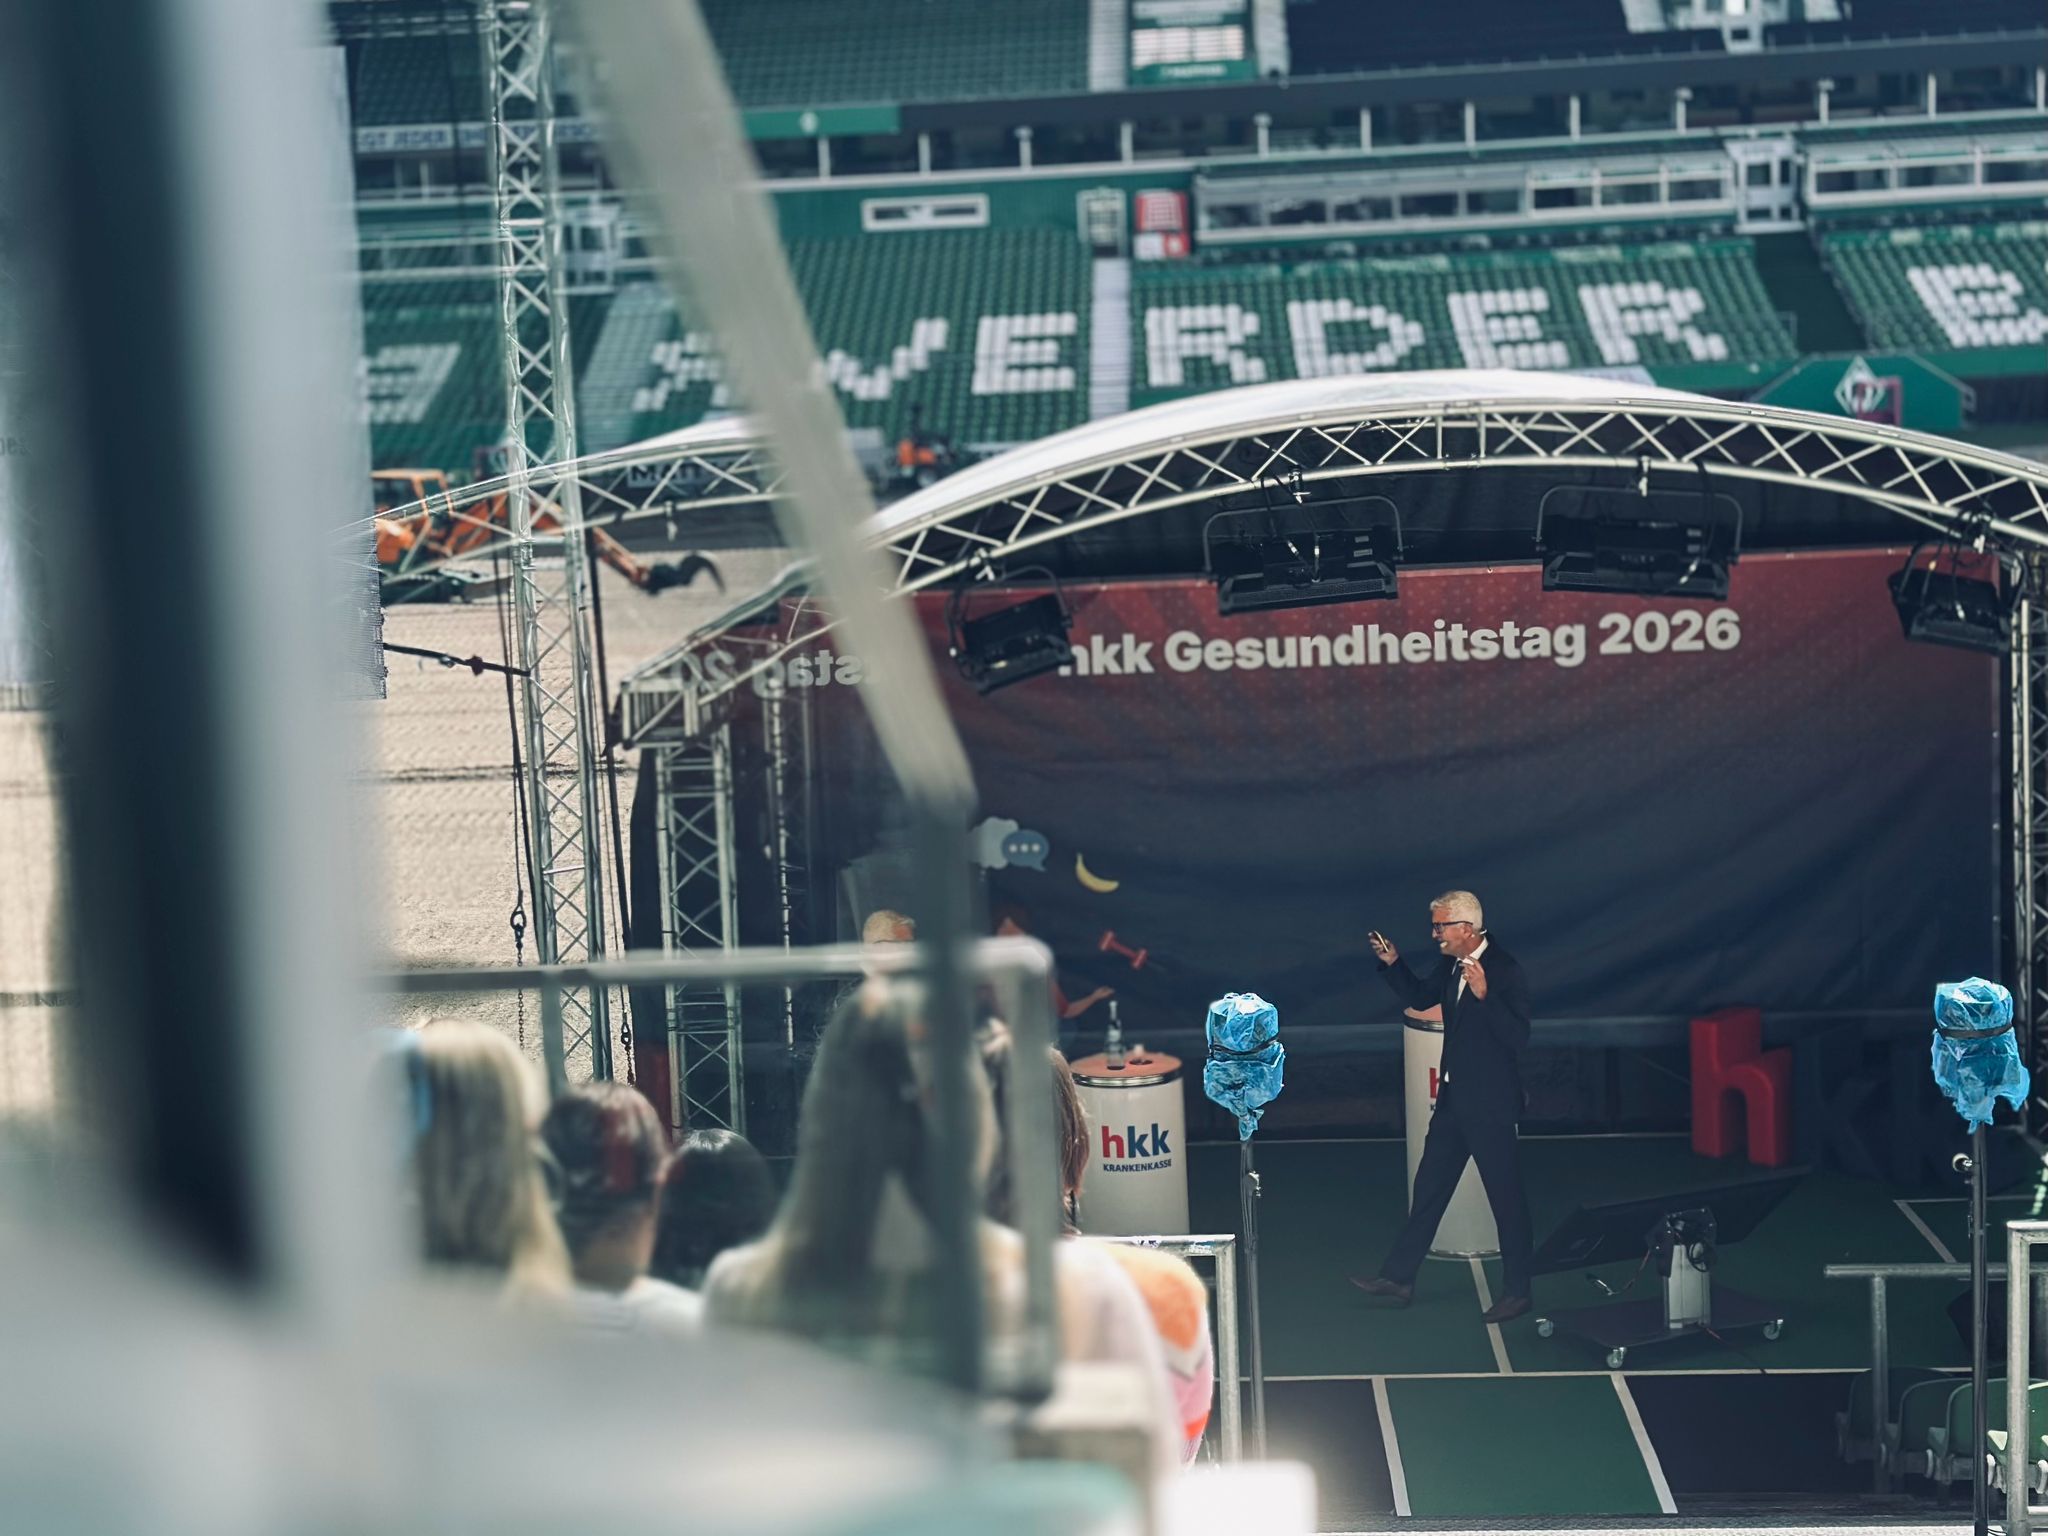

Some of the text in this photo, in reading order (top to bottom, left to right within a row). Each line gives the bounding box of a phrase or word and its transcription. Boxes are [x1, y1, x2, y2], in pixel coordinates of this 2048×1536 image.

[1164, 618, 1587, 672] Gesundheitstag
[1599, 607, 1741, 655] 2026
[1101, 1123, 1171, 1158] hkk
[1103, 1159, 1172, 1172] KRANKENKASSE
